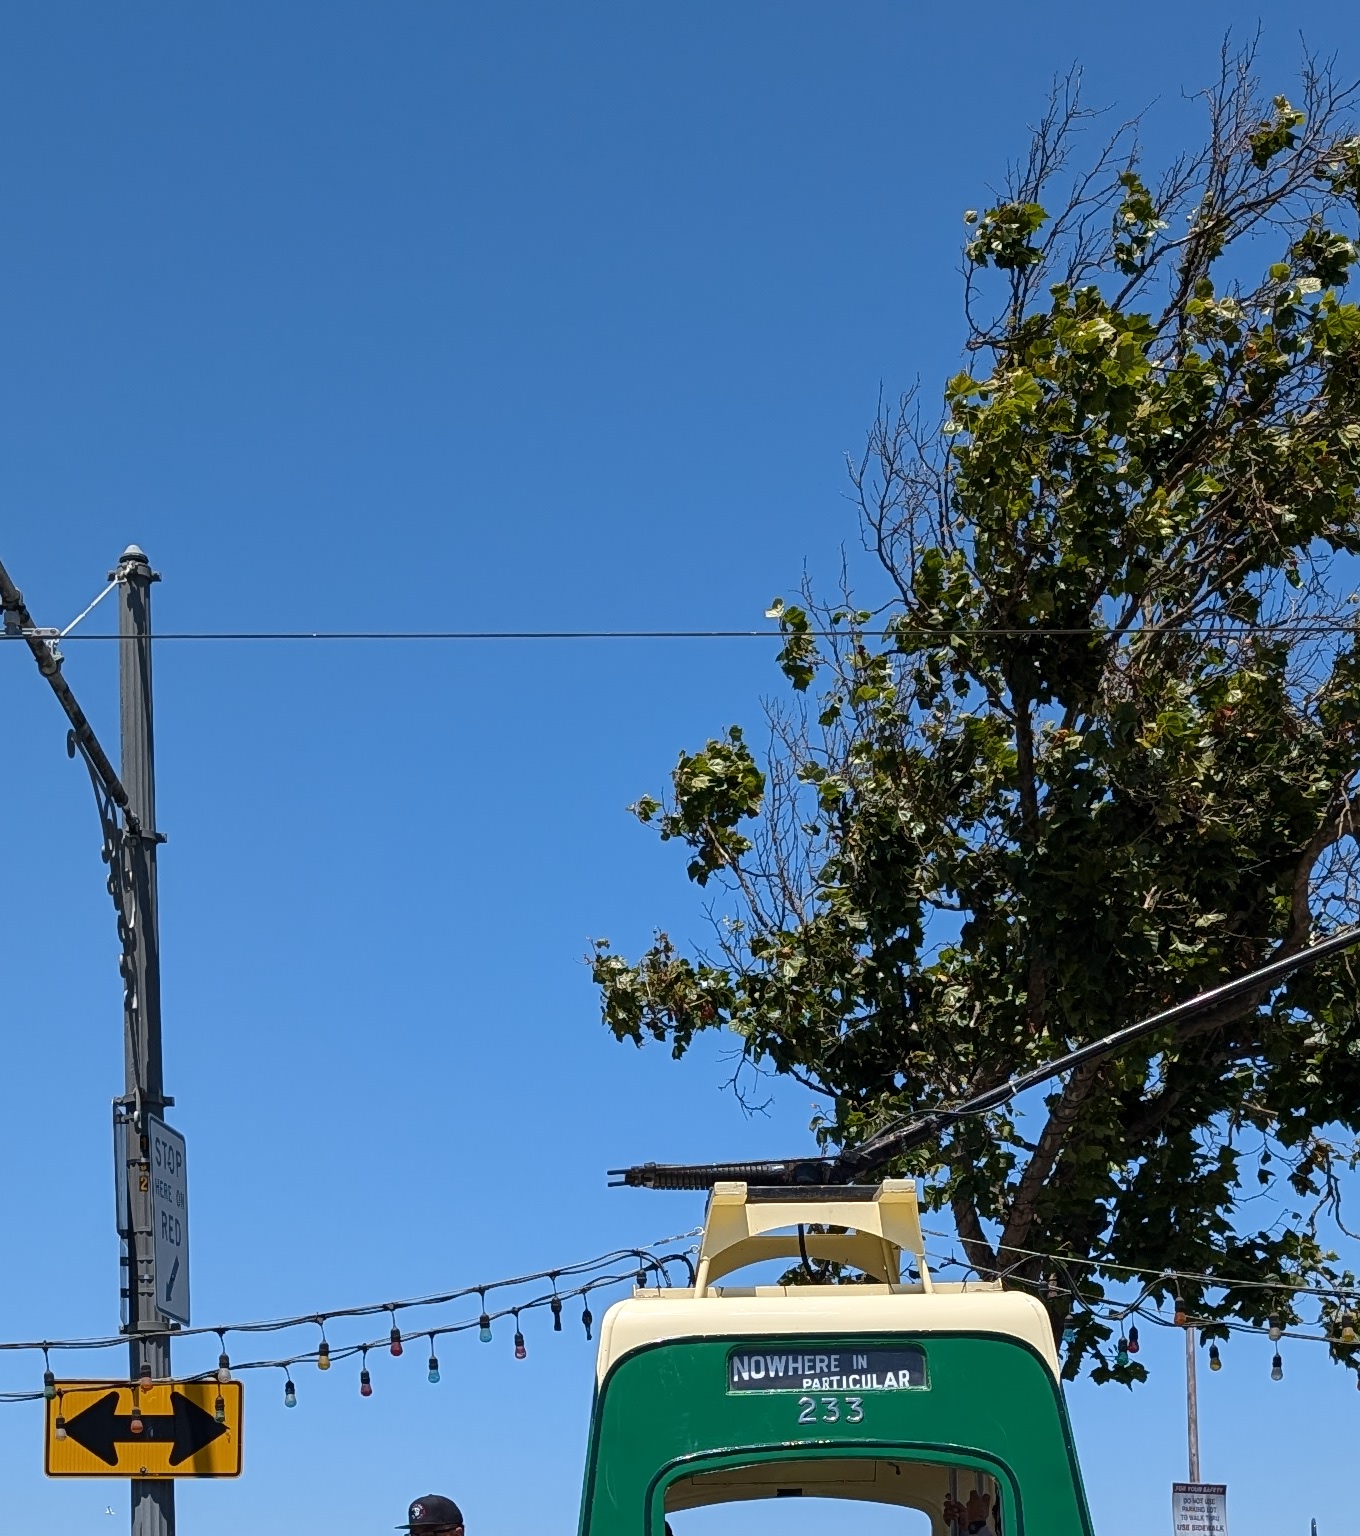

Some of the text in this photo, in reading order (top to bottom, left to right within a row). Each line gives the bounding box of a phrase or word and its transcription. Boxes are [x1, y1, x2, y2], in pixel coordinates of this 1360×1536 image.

[155, 1137, 182, 1178] STOP
[155, 1178, 185, 1210] HERE ON
[161, 1210, 181, 1247] RED
[733, 1355, 868, 1382] NOWHERE IN
[802, 1370, 910, 1390] PARTICULAR
[798, 1397, 865, 1424] 233
